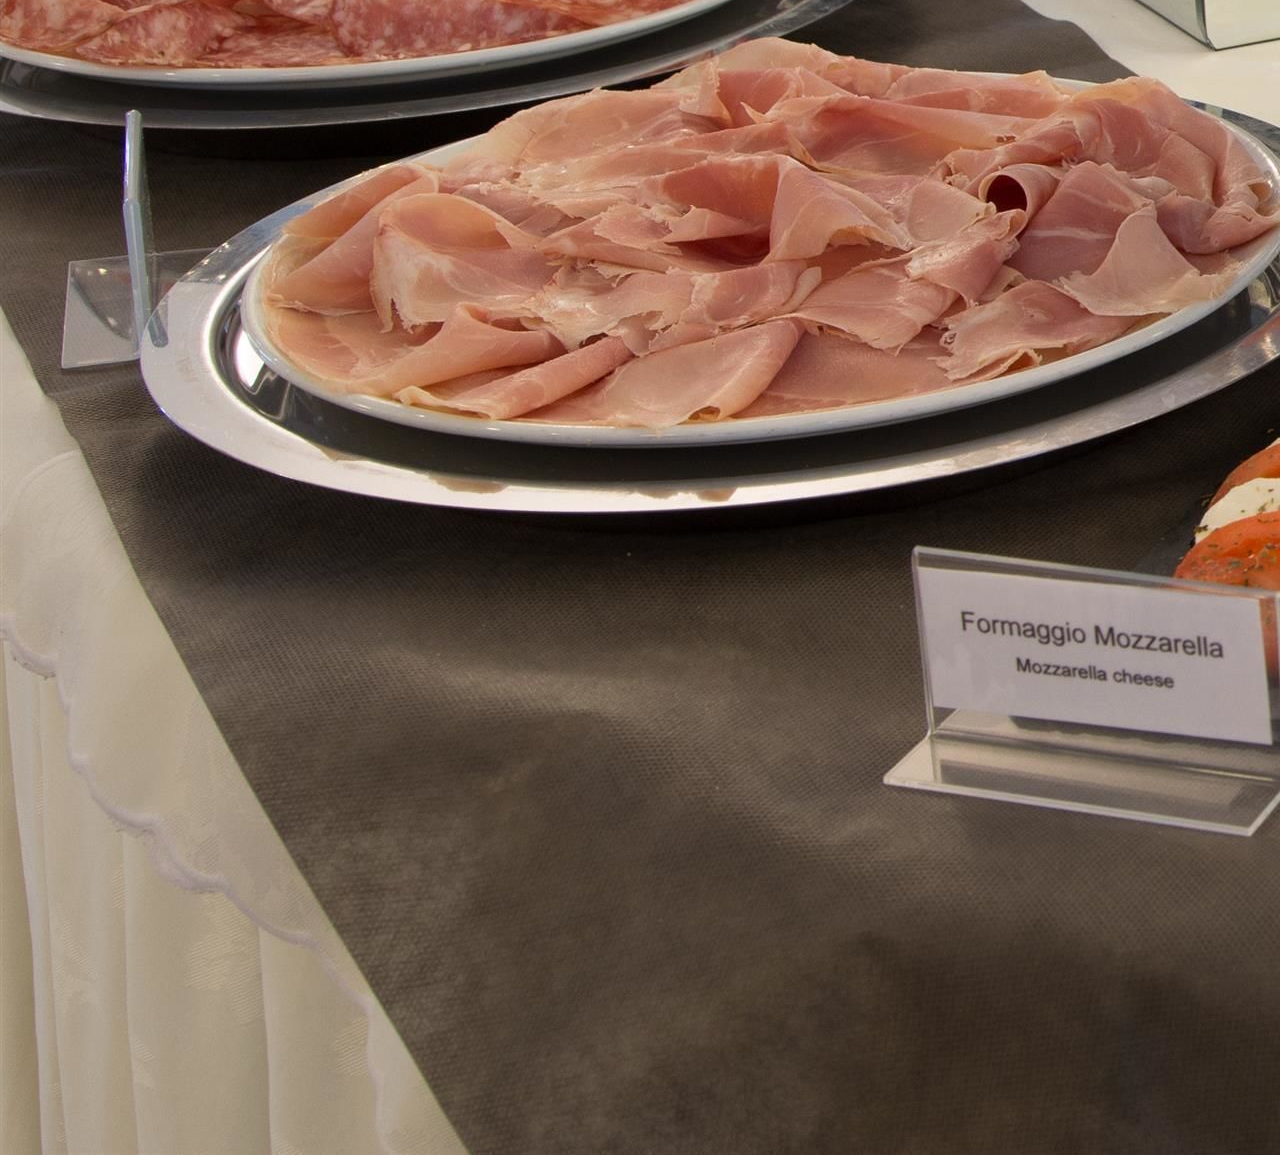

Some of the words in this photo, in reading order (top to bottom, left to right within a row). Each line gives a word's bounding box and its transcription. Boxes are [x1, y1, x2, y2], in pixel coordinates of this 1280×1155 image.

[960, 610, 1087, 648] Formaggio
[1093, 624, 1225, 660] Mozzarella
[1016, 656, 1109, 683] Mozzarella
[1113, 667, 1175, 690] cheese
